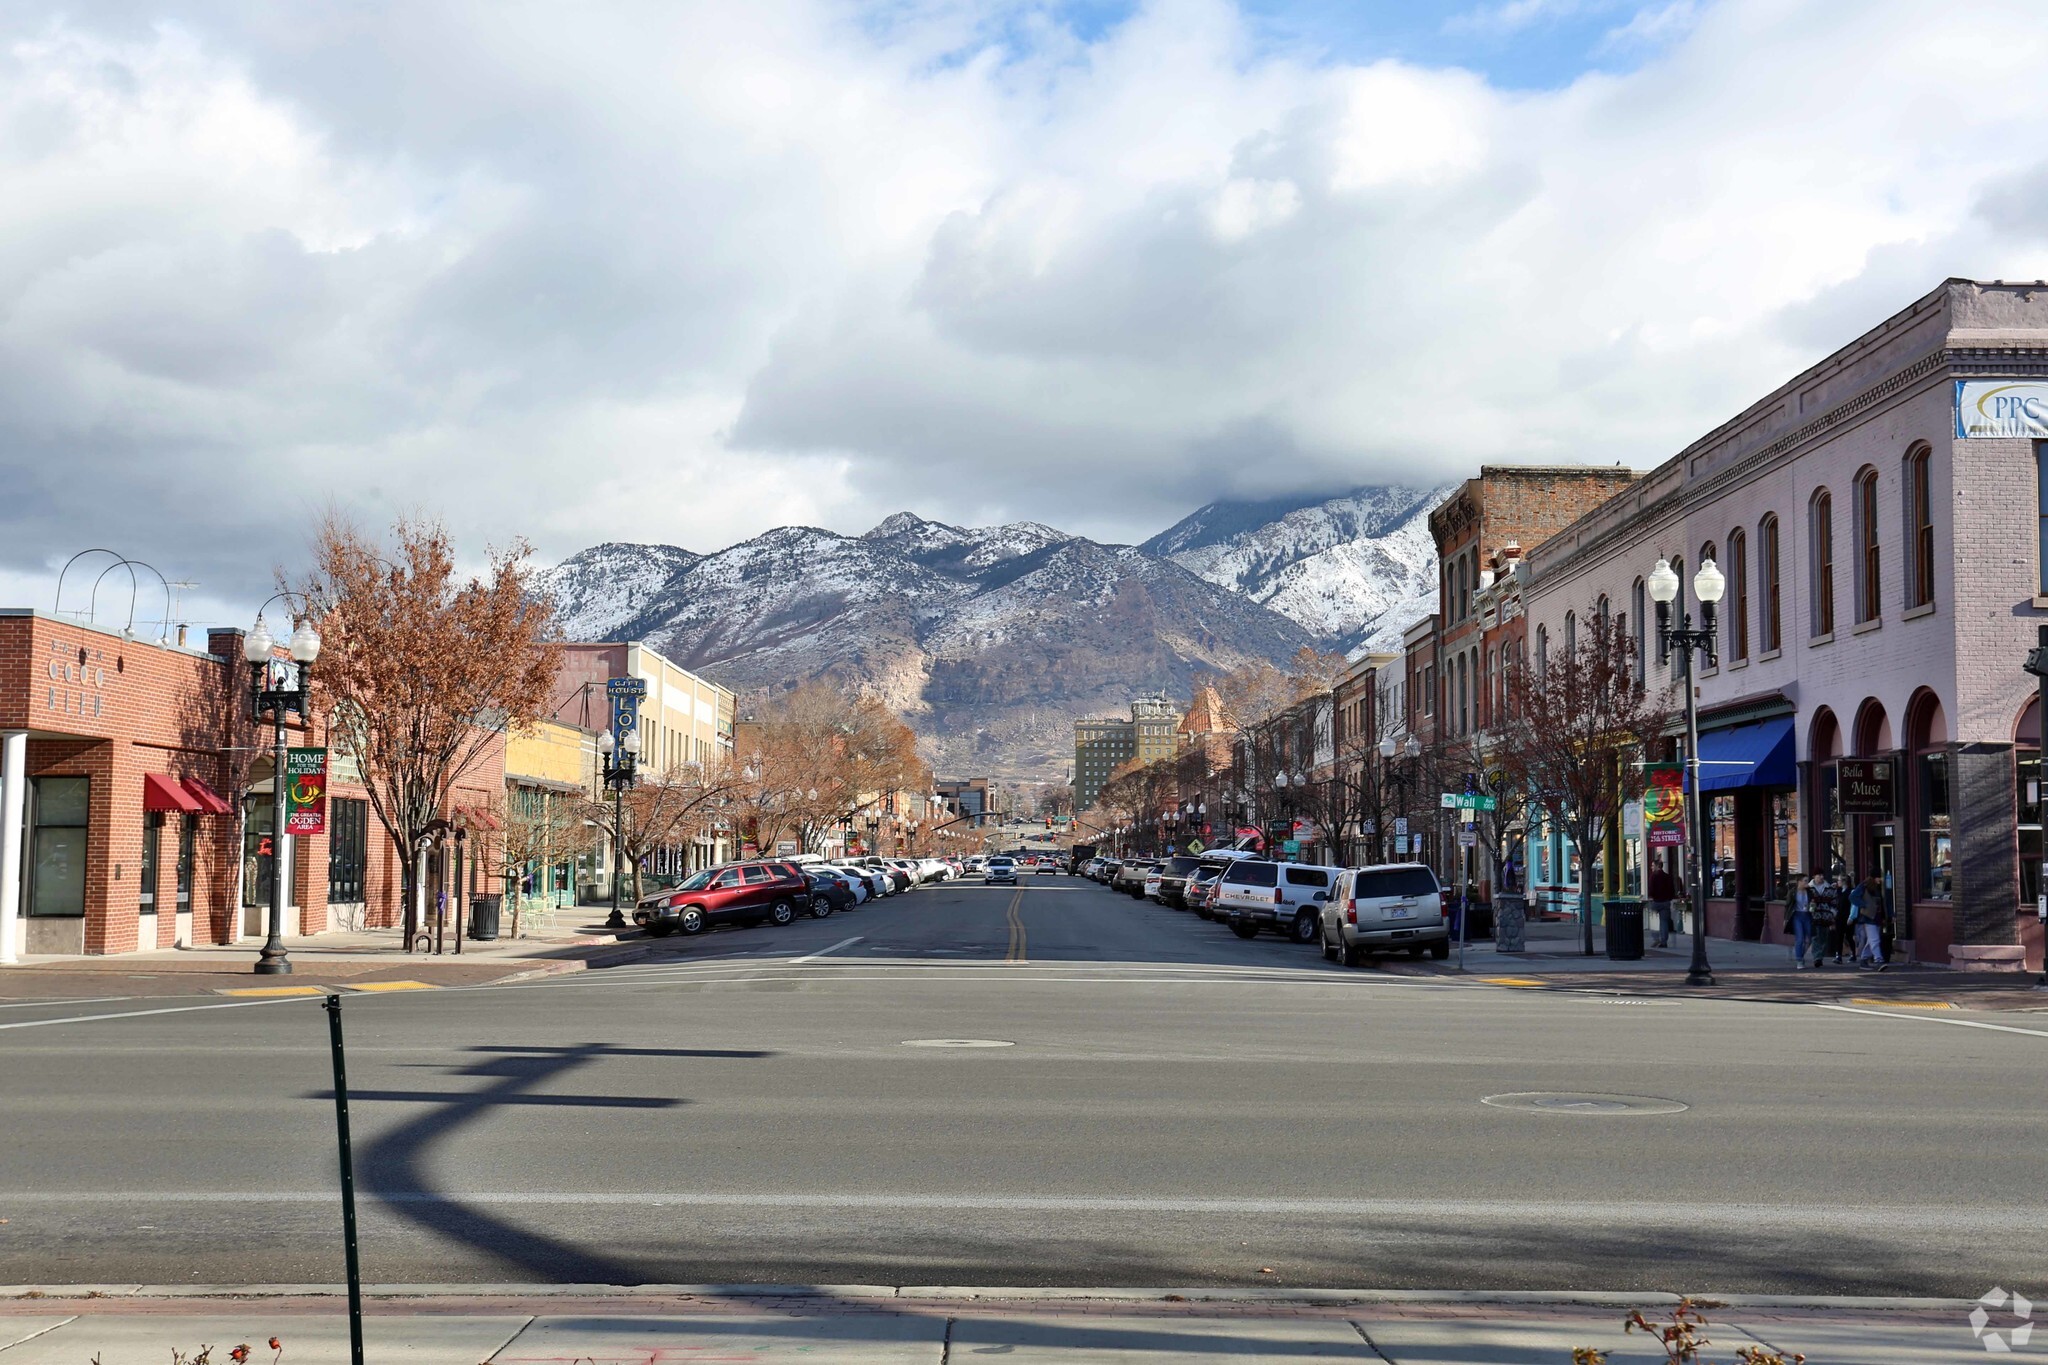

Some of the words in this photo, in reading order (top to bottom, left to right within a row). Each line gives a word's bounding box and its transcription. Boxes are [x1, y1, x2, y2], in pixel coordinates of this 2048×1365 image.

[1994, 396, 2040, 419] PPC
[49, 686, 101, 718] BLEU
[289, 753, 325, 764] HOME
[288, 767, 326, 775] HOLIDAYS
[1842, 764, 1863, 778] Bella
[1851, 781, 1881, 796] Muse
[1456, 796, 1476, 807] Wall
[289, 817, 321, 825] OGDEN
[1224, 893, 1270, 902] CHEVROLET
